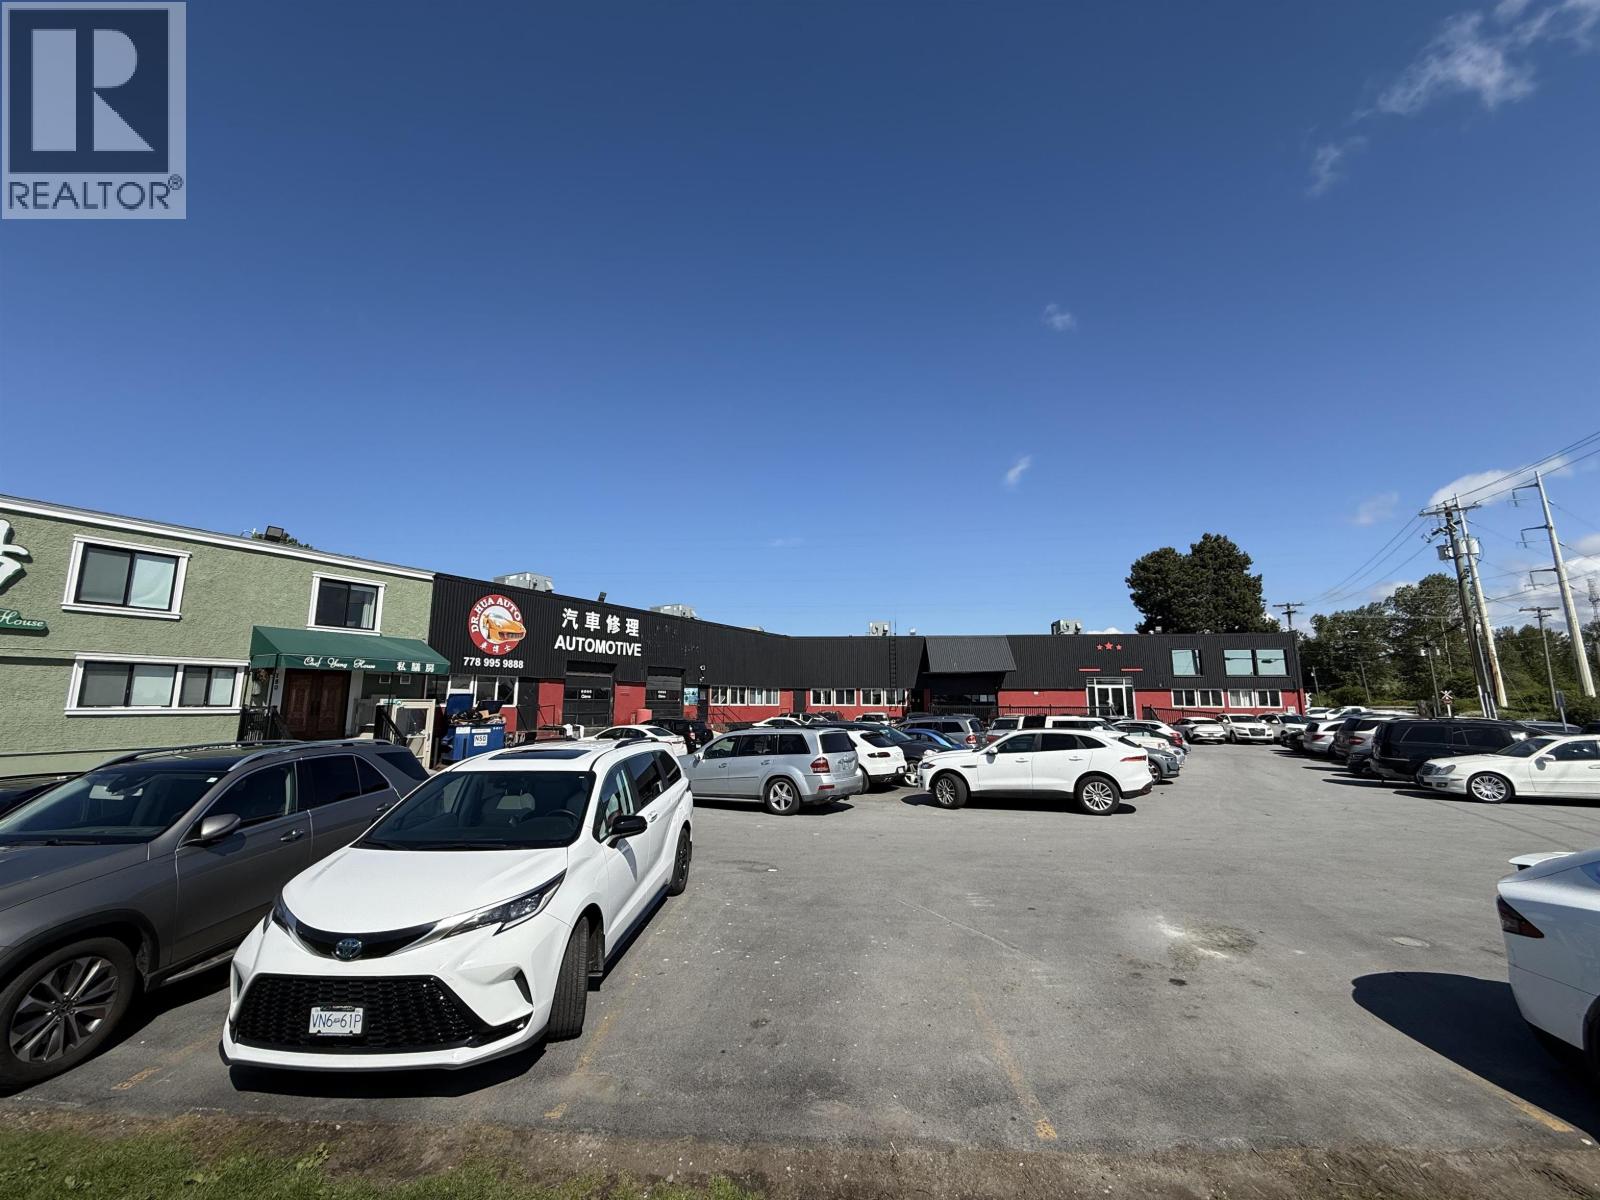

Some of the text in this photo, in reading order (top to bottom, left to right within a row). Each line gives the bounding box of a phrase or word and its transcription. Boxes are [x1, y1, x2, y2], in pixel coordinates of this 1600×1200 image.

[0, 610, 45, 628] House
[496, 597, 521, 621] AUTO
[561, 607, 640, 638] 汽車修理
[554, 634, 642, 657] AUTOMOTIVE
[463, 656, 524, 669] 778 995 9888
